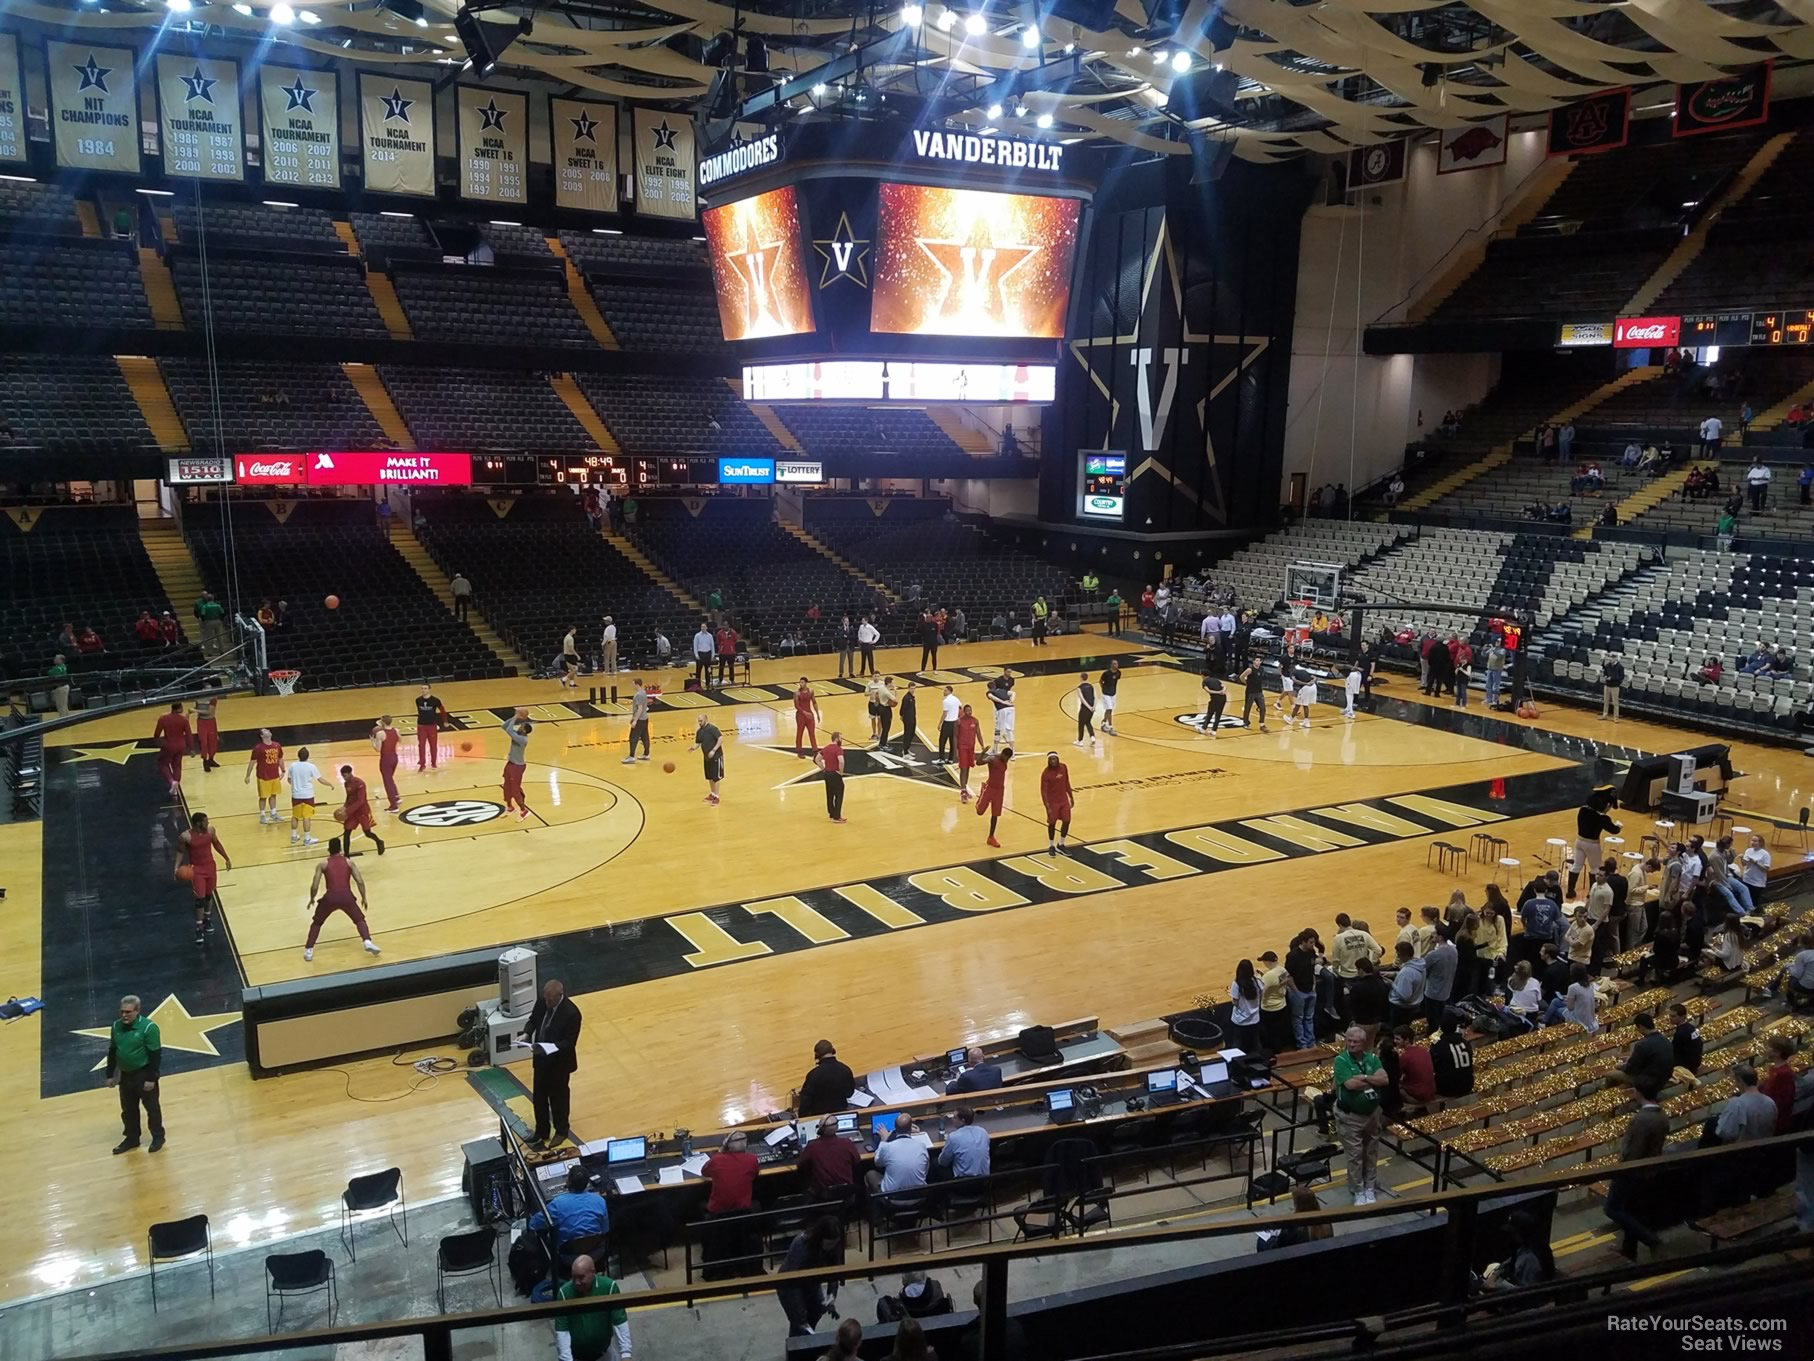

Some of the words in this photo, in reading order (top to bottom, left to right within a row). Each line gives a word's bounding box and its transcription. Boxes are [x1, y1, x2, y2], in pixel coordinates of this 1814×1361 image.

[84, 97, 104, 111] NIT
[61, 109, 129, 126] CHAMPIONS
[188, 109, 214, 122] NCAA
[170, 119, 232, 135] TOURNAMENT
[288, 118, 313, 130] NCAA
[173, 133, 198, 144] 1986
[210, 136, 233, 147] 1987
[271, 128, 330, 143] TOURNAMENT
[386, 128, 410, 140] NCAA
[77, 138, 115, 156] 1984
[273, 141, 298, 153] 2006
[308, 144, 331, 156] 2007
[370, 137, 426, 152] TOURNAMENT
[483, 137, 504, 149] NCAA
[174, 146, 198, 158] 1989
[210, 149, 234, 161] 1998
[372, 150, 395, 162] 2014
[474, 148, 499, 160] SWEET
[503, 150, 513, 161] 16
[576, 147, 596, 159] NCAA
[913, 130, 1063, 170] VANDERBILT
[274, 156, 298, 168] 2010
[308, 159, 331, 170] 2011
[568, 158, 591, 169] SWEET
[594, 160, 604, 170] 16
[656, 156, 675, 167] NCAA
[699, 134, 778, 184] COMMODORES
[175, 160, 200, 172] 2000
[211, 162, 236, 174] 2003
[469, 159, 490, 171] 1990
[499, 162, 519, 173] 1991
[645, 165, 663, 176] ELITE
[666, 167, 686, 178] EIGHT
[275, 170, 299, 182] 2012
[309, 173, 333, 184] 2013
[470, 171, 490, 183] 1994
[500, 175, 520, 186] 1995
[562, 168, 582, 179] 2005
[645, 176, 663, 187] 1992
[470, 184, 490, 195] 1997
[499, 187, 520, 198] 2004
[644, 189, 662, 199] 2001
[672, 192, 689, 202] 2002
[832, 243, 853, 271] V
[1767, 317, 1775, 328] 4
[1772, 330, 1781, 342] 0
[1799, 330, 1807, 342] 0
[1130, 348, 1189, 450] V
[387, 457, 417, 467] MAKE
[420, 457, 430, 467] IT
[550, 459, 557, 469] 4
[585, 457, 612, 467] 48:49
[640, 460, 646, 470] 4
[181, 466, 220, 475] 1510
[379, 469, 439, 480] BRILLIANT!
[557, 472, 564, 482] 0
[640, 472, 646, 482] 0
[580, 473, 587, 482] 0
[620, 473, 626, 483] 0
[276, 504, 287, 514] B
[497, 501, 506, 511] C
[691, 501, 699, 510] D
[18, 511, 32, 523] A
[1503, 625, 1521, 636] 48:49
[1504, 634, 1518, 650] 30
[1145, 768, 1227, 782] Memorial
[664, 794, 1510, 968] VANDERBILT
[1449, 1042, 1470, 1069] 16
